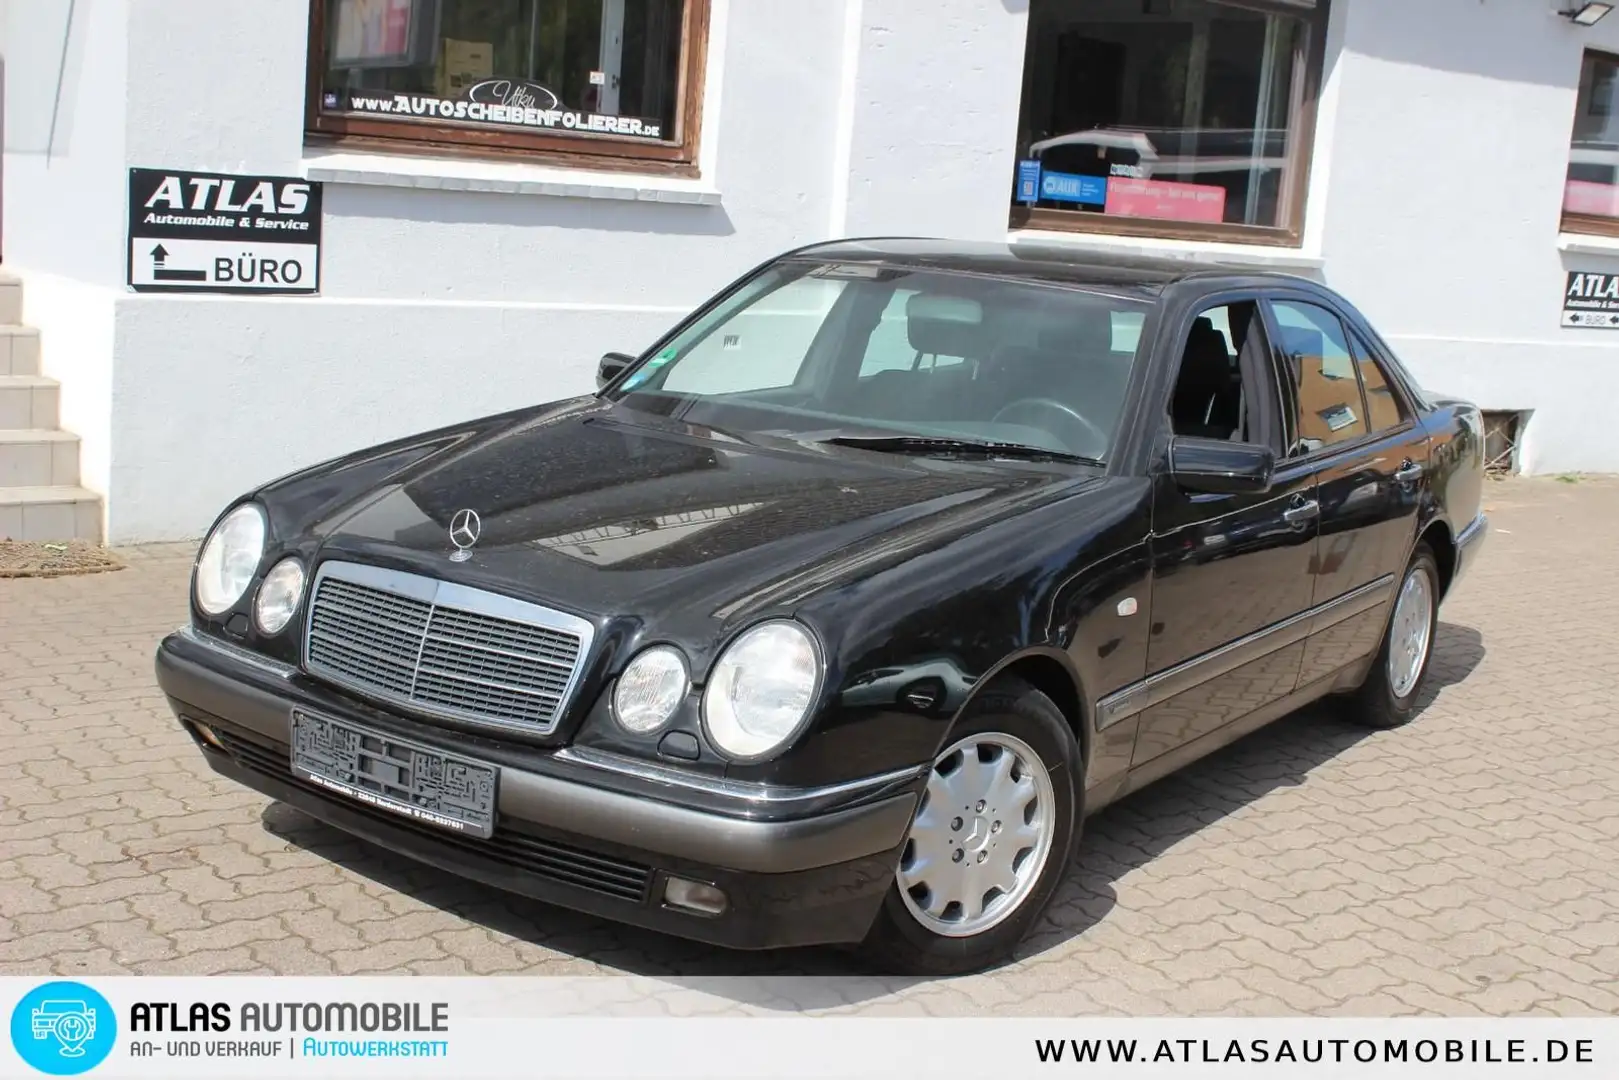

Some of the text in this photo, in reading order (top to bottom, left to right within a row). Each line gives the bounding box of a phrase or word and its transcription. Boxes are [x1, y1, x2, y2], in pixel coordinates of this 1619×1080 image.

[144, 176, 310, 215] ATLAS
[144, 212, 309, 231] Automobile & Service
[214, 252, 302, 284] BÜRO
